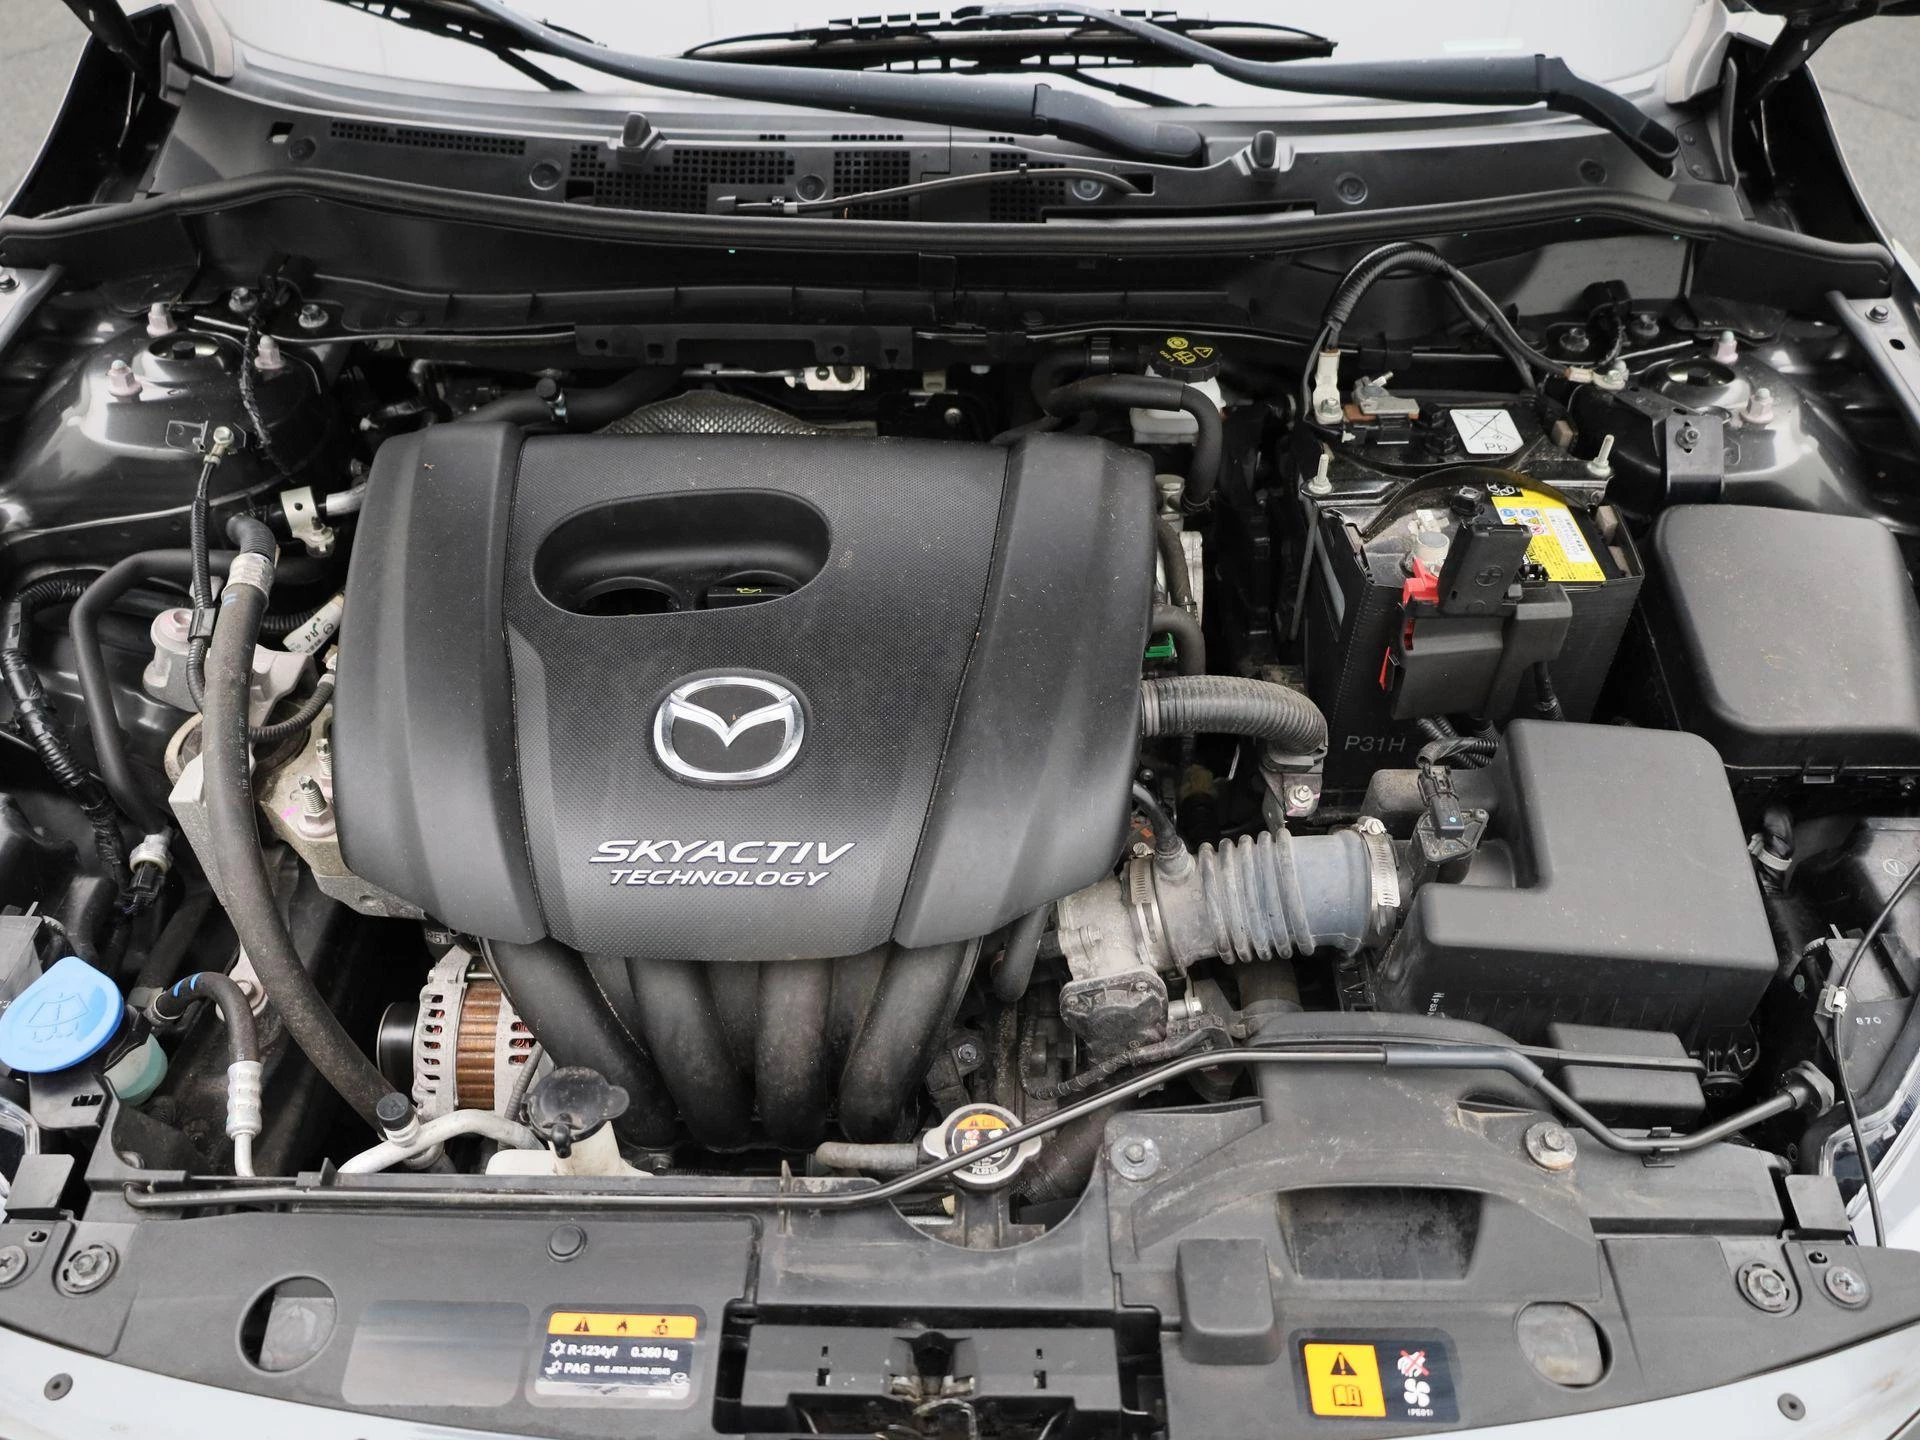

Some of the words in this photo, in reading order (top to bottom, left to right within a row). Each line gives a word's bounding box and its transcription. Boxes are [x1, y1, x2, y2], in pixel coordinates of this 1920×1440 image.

[1344, 735, 1406, 752] P31H
[588, 839, 856, 865] SKYACTIV
[610, 869, 831, 887] TECHNOLOGY
[567, 1344, 618, 1359] R-1234yf
[662, 1347, 679, 1361] kg
[563, 1362, 590, 1374] PAG
